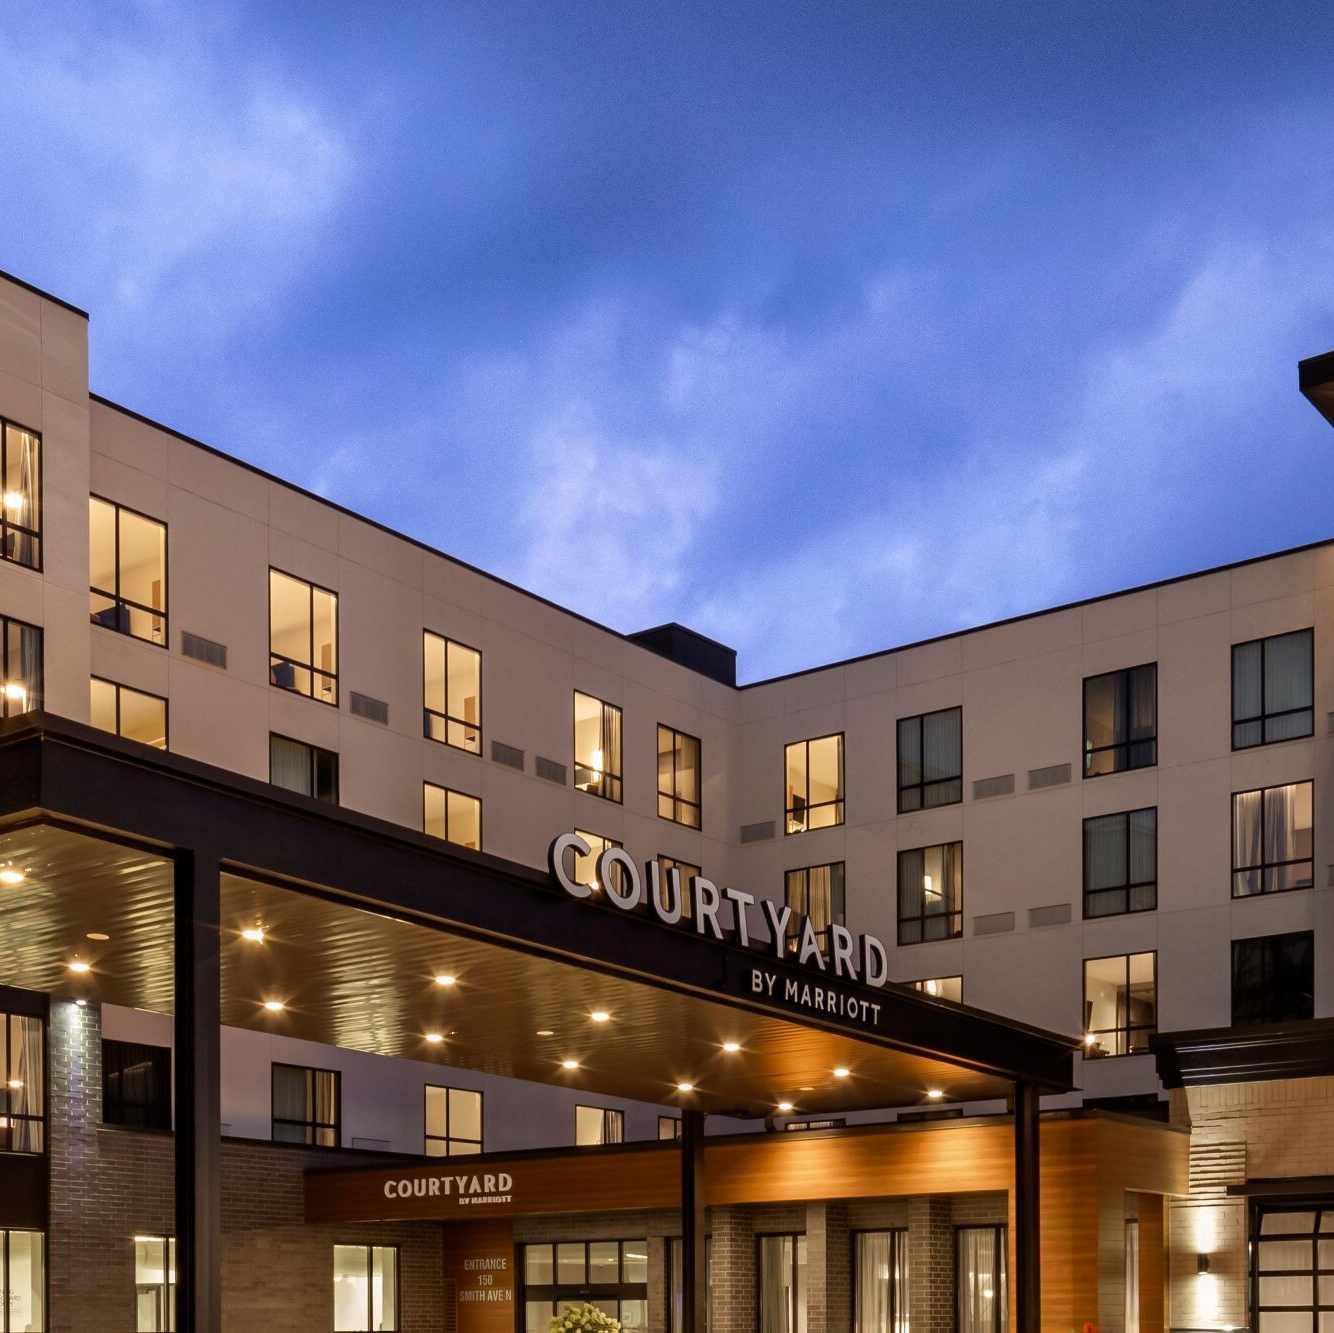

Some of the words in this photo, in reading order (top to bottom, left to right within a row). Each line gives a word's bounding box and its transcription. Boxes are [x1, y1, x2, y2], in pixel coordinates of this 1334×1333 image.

[549, 832, 889, 987] COURTYARD
[751, 969, 777, 997] BY
[785, 980, 881, 1026] MARRIOTT
[384, 1173, 513, 1198] COURTYARD
[459, 1197, 470, 1205] BY
[471, 1195, 512, 1204] MARRIOTT
[464, 1258, 507, 1270] ENTRANCE
[477, 1274, 493, 1286] 150
[459, 1290, 486, 1302] SMITH
[487, 1290, 504, 1301] AVE
[505, 1289, 512, 1301] N
